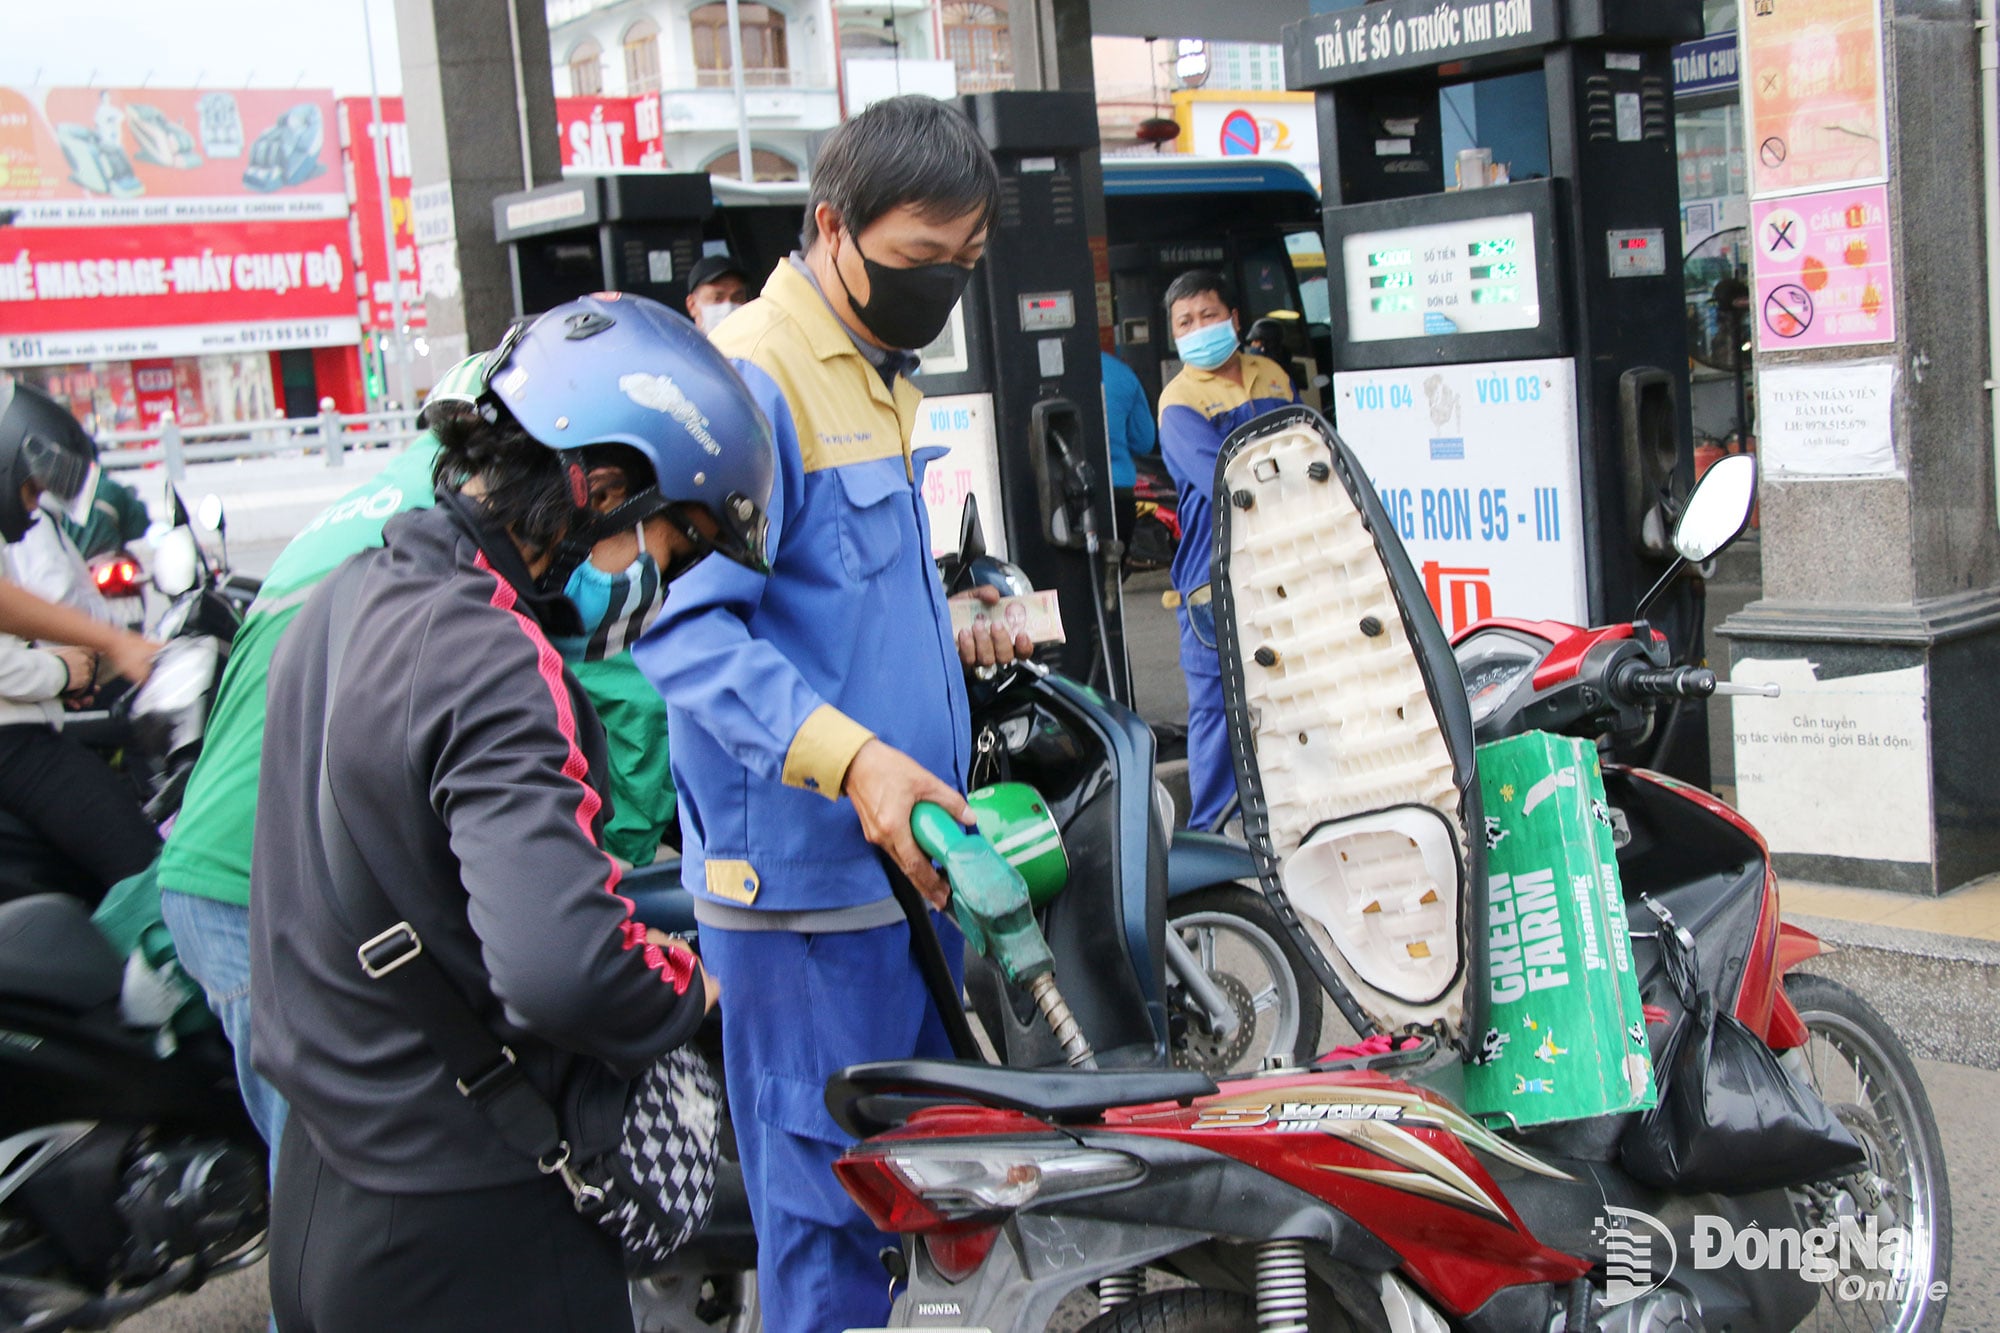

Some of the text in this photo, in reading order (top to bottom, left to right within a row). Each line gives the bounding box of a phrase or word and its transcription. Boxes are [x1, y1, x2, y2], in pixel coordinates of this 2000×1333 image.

[1315, 18, 1345, 69] TRẢ
[1347, 14, 1367, 64] VỀ
[1371, 9, 1392, 60] SỐ
[1408, 3, 1460, 53] TRƯỚC
[1463, 4, 1491, 44] KHI
[1495, 0, 1532, 38] BƠM
[1673, 50, 1707, 84] TOÁN
[1851, 201, 1882, 228] LỬA
[234, 253, 303, 295] CHẠY
[305, 244, 343, 293] BỘ
[8, 339, 44, 359] 501
[1354, 379, 1413, 411] VÒI 04
[1476, 371, 1541, 404] VÒI 03
[929, 405, 970, 432] VÒI 05
[927, 470, 945, 506] 95
[1373, 480, 1415, 540] NG
[1421, 487, 1472, 541] RON
[1479, 487, 1509, 542] 95
[1793, 714, 1857, 732] Cần tuyển
[1751, 732, 1769, 744] tác
[1772, 732, 1797, 744] viên
[1801, 733, 1824, 745] môi
[1828, 734, 1854, 748] giới
[1858, 731, 1879, 747] Bất
[1883, 734, 1912, 750] độn
[1602, 863, 1620, 912] FARM
[1488, 867, 1570, 1005] GREEN FARM
[1573, 874, 1600, 970] Vinamilk
[1611, 916, 1628, 973] GREEN
[918, 1302, 961, 1316] HONDA
